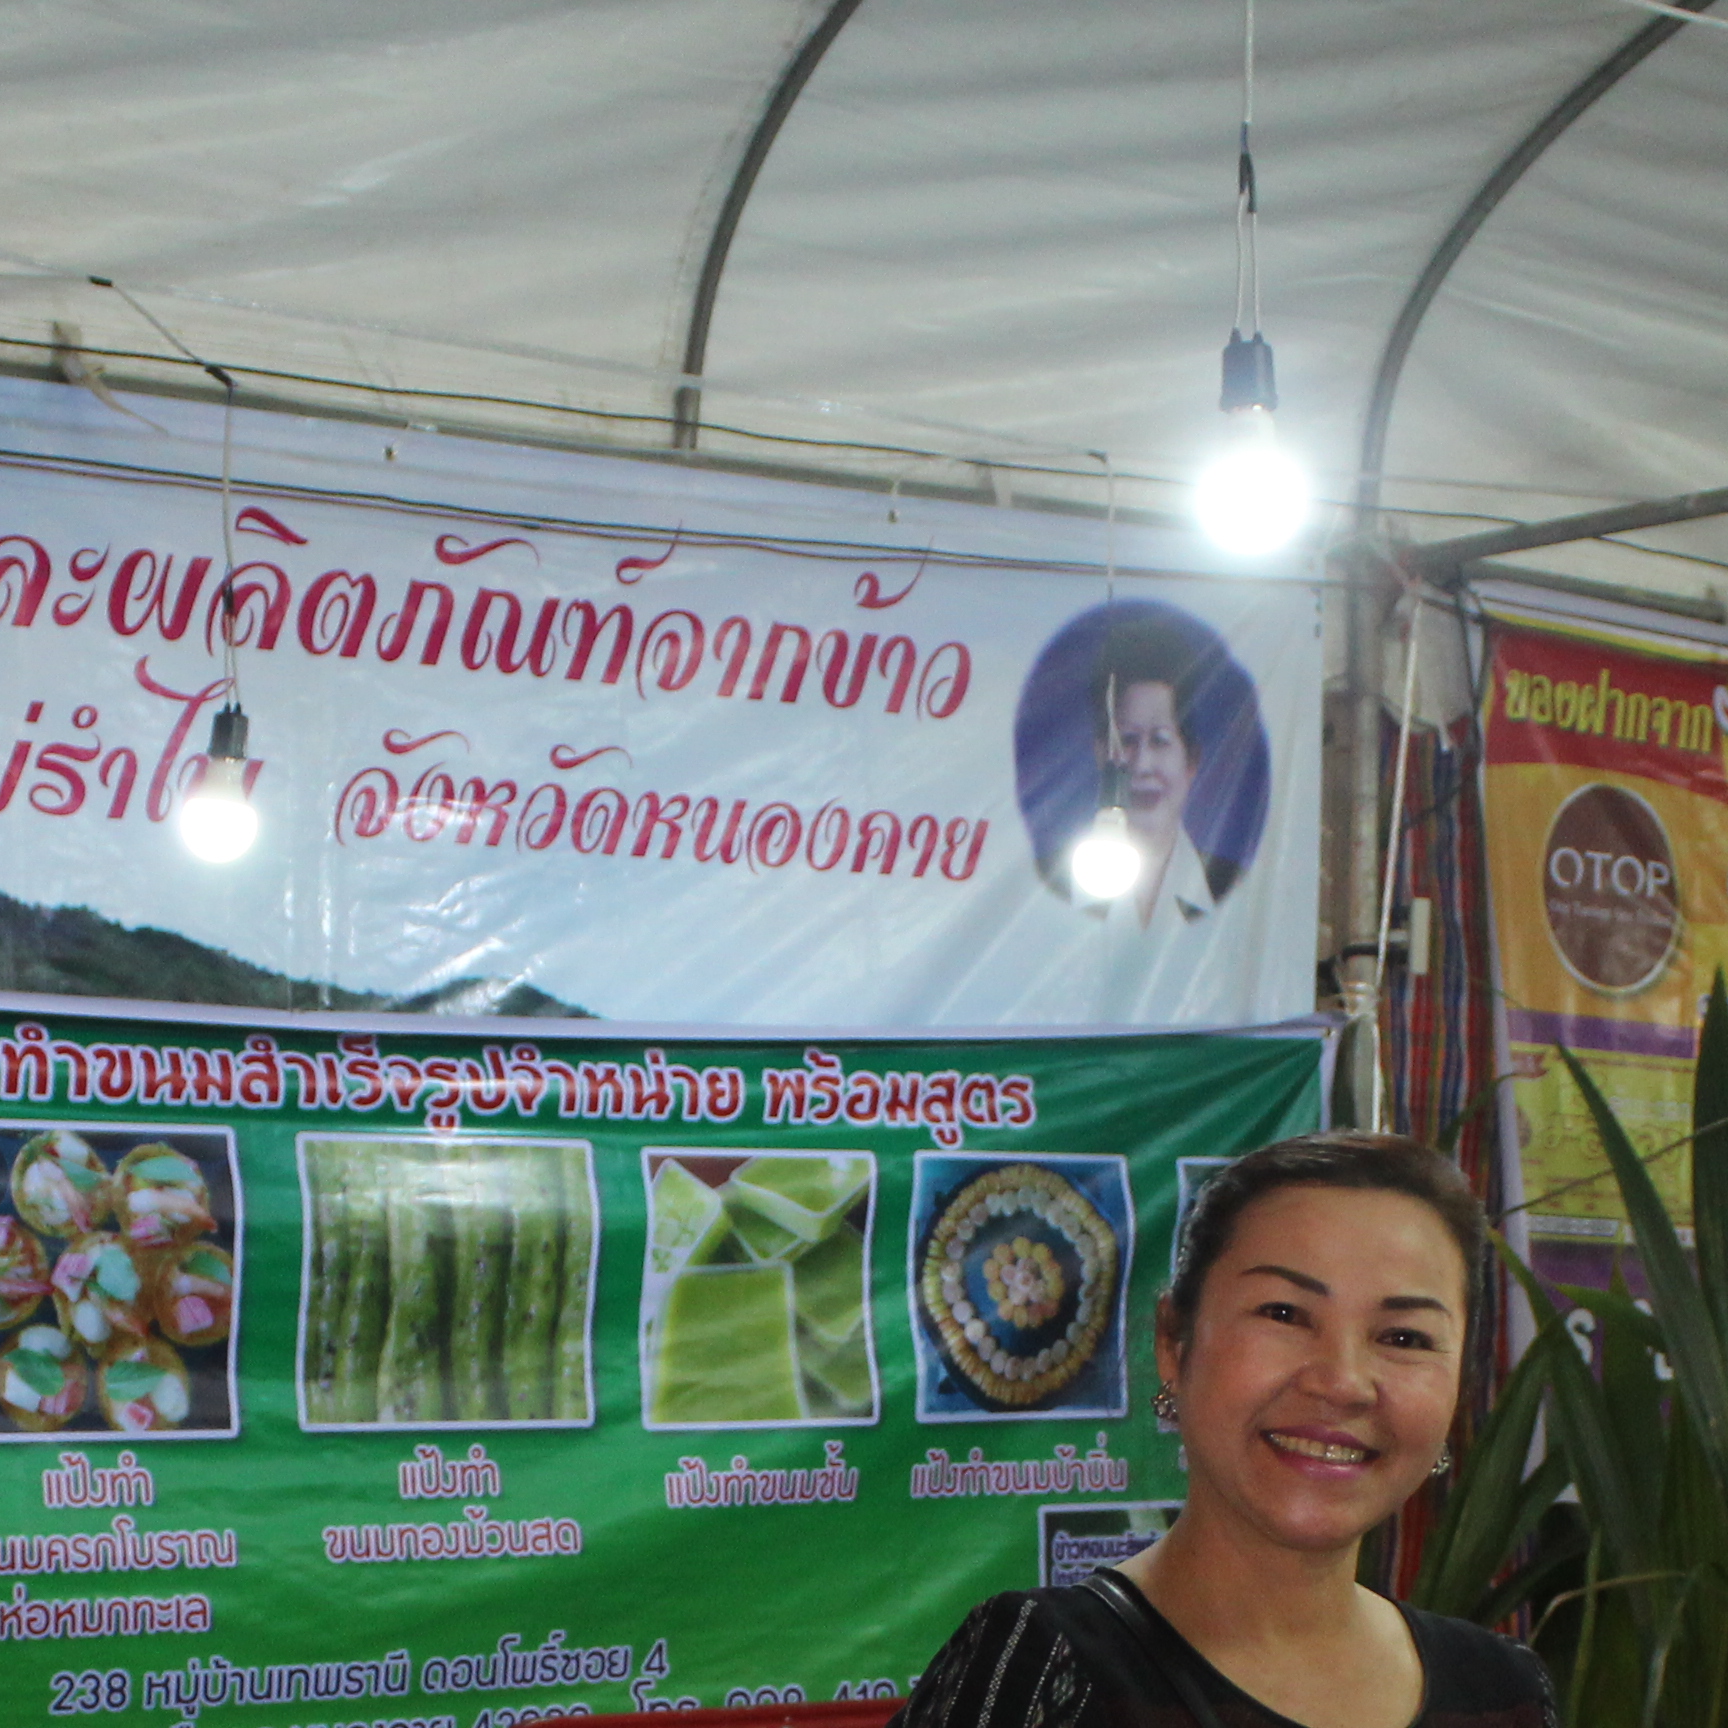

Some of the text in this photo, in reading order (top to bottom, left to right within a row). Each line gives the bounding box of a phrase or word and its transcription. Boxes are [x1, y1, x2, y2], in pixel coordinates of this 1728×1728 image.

[1504, 665, 1716, 754] ของฝากจาก
[334, 727, 988, 883] จังหวัดหนองคาย
[1549, 845, 1671, 899] OTOP
[762, 1048, 1037, 1147] พร้อมสูตร
[42, 1451, 154, 1509] แป้งทำ
[398, 1444, 501, 1501] แป้งทำ
[663, 1440, 859, 1511] แป้งทำขนมชั้น
[910, 1431, 1128, 1499] แป้งทำขนมบ้าบิ่น
[322, 1505, 583, 1563] ขนมทองม้วนสด
[48, 1669, 130, 1715] 238
[641, 1640, 668, 1679] 4
